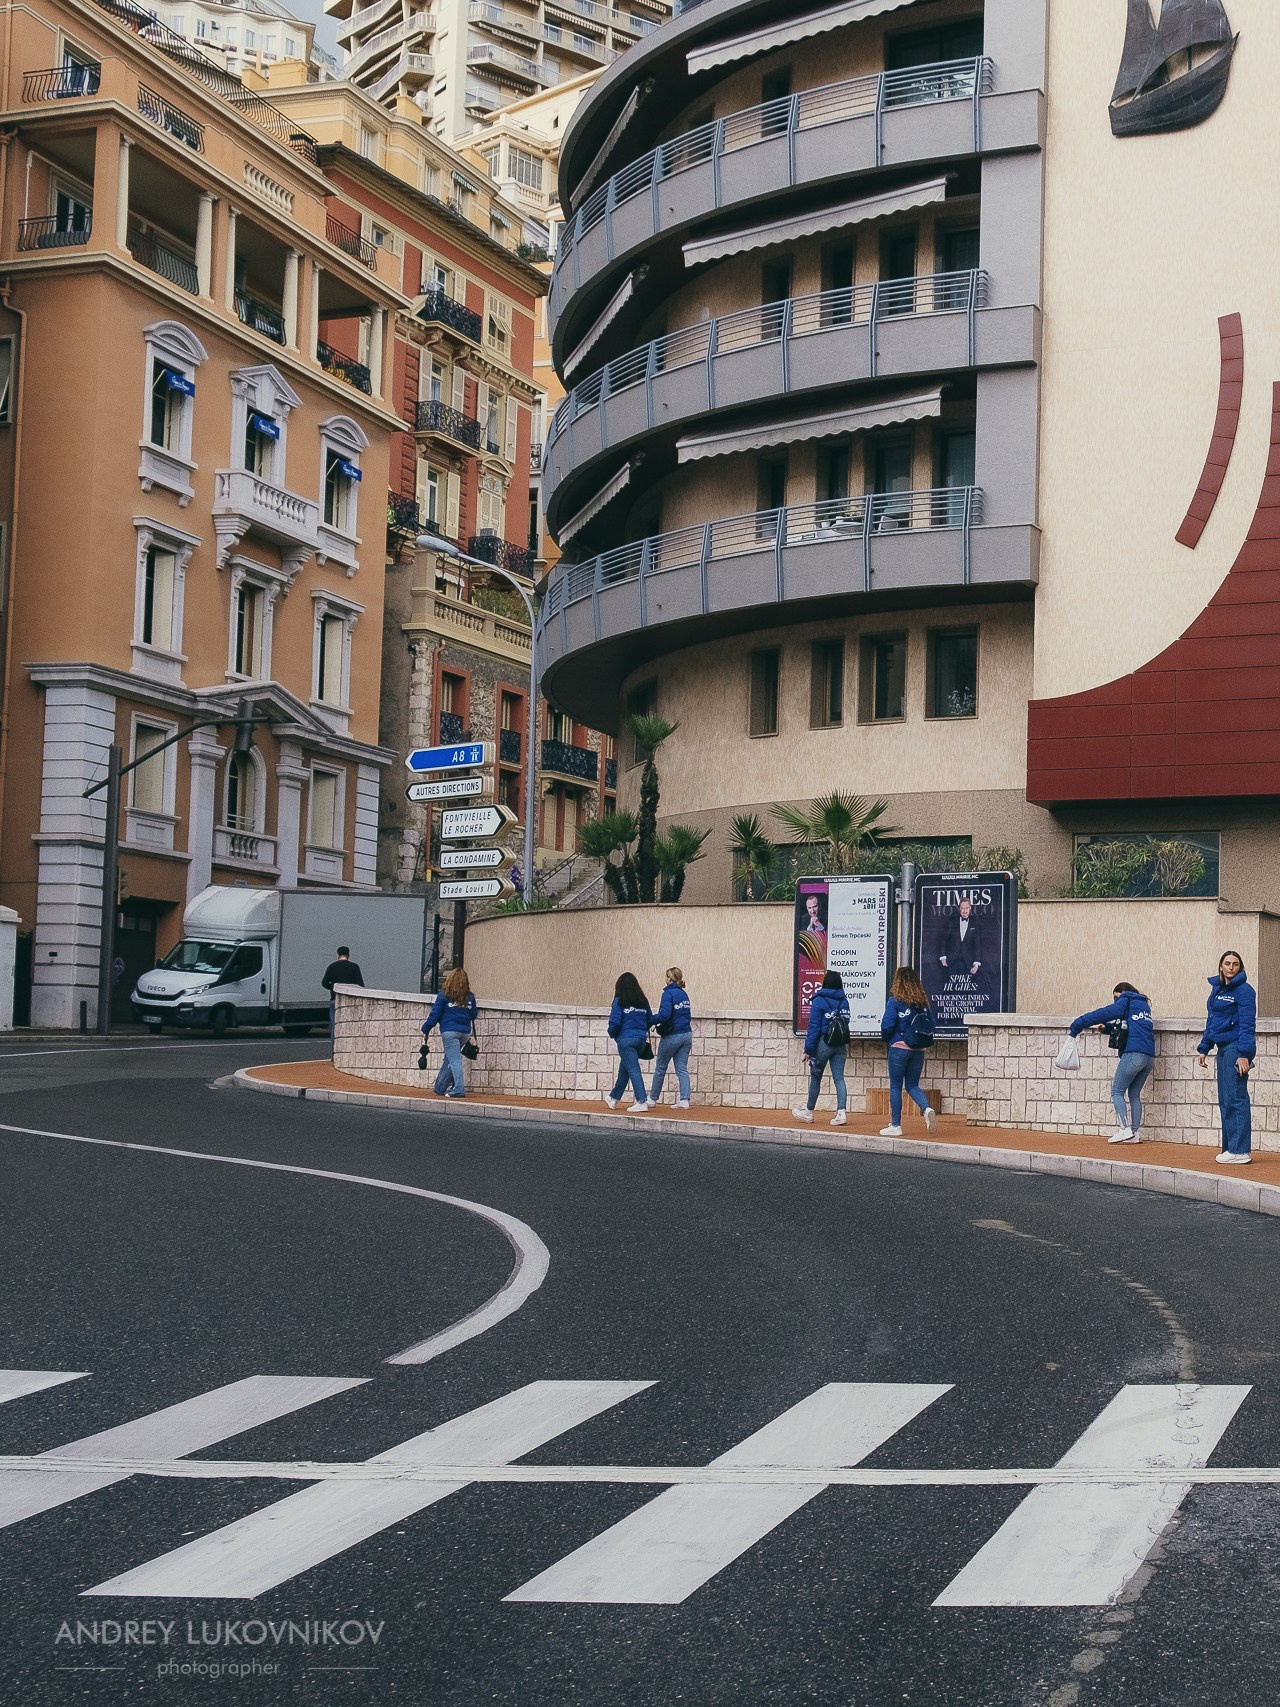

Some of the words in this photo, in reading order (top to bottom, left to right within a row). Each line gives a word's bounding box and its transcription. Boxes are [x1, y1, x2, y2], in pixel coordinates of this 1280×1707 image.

[451, 750, 466, 763] A8
[416, 786, 440, 797] AUTRES
[442, 781, 480, 794] DIRECTIONS
[444, 811, 492, 823] FONTVIEILLE
[444, 825, 452, 835] LE
[454, 823, 484, 834] ROCHER
[443, 856, 452, 865] LA
[454, 853, 496, 864] CONDAMINE
[442, 885, 462, 895] Stade
[465, 883, 484, 894] Louis
[932, 888, 992, 907] TIMES
[877, 935, 886, 967] SIMON
[840, 969, 876, 978] HAÏKOVSKY
[949, 974, 973, 983] SPIKE
[842, 981, 870, 989] THOVEN
